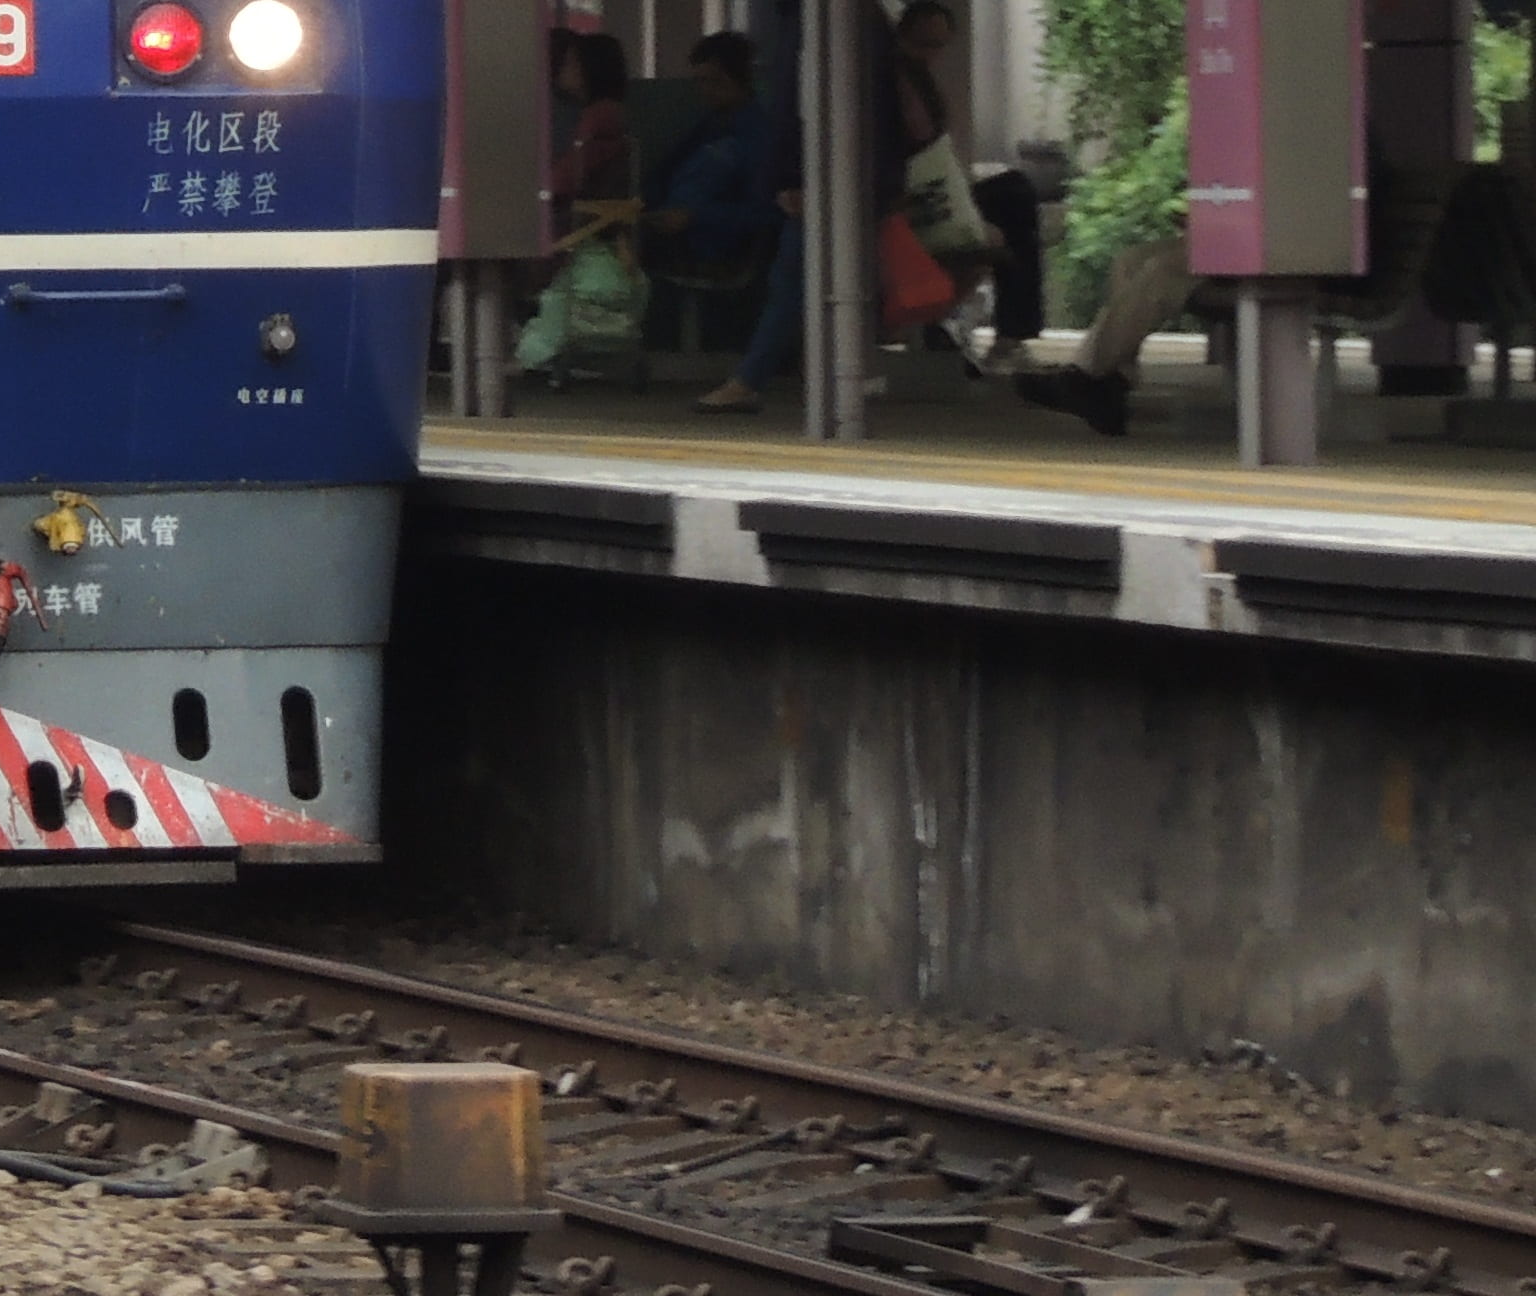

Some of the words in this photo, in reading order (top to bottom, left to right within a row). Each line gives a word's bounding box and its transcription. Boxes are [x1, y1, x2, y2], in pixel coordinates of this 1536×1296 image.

[147, 110, 282, 154] 电化区段
[141, 170, 278, 217] 严禁攀登
[87, 514, 179, 547] 供风管
